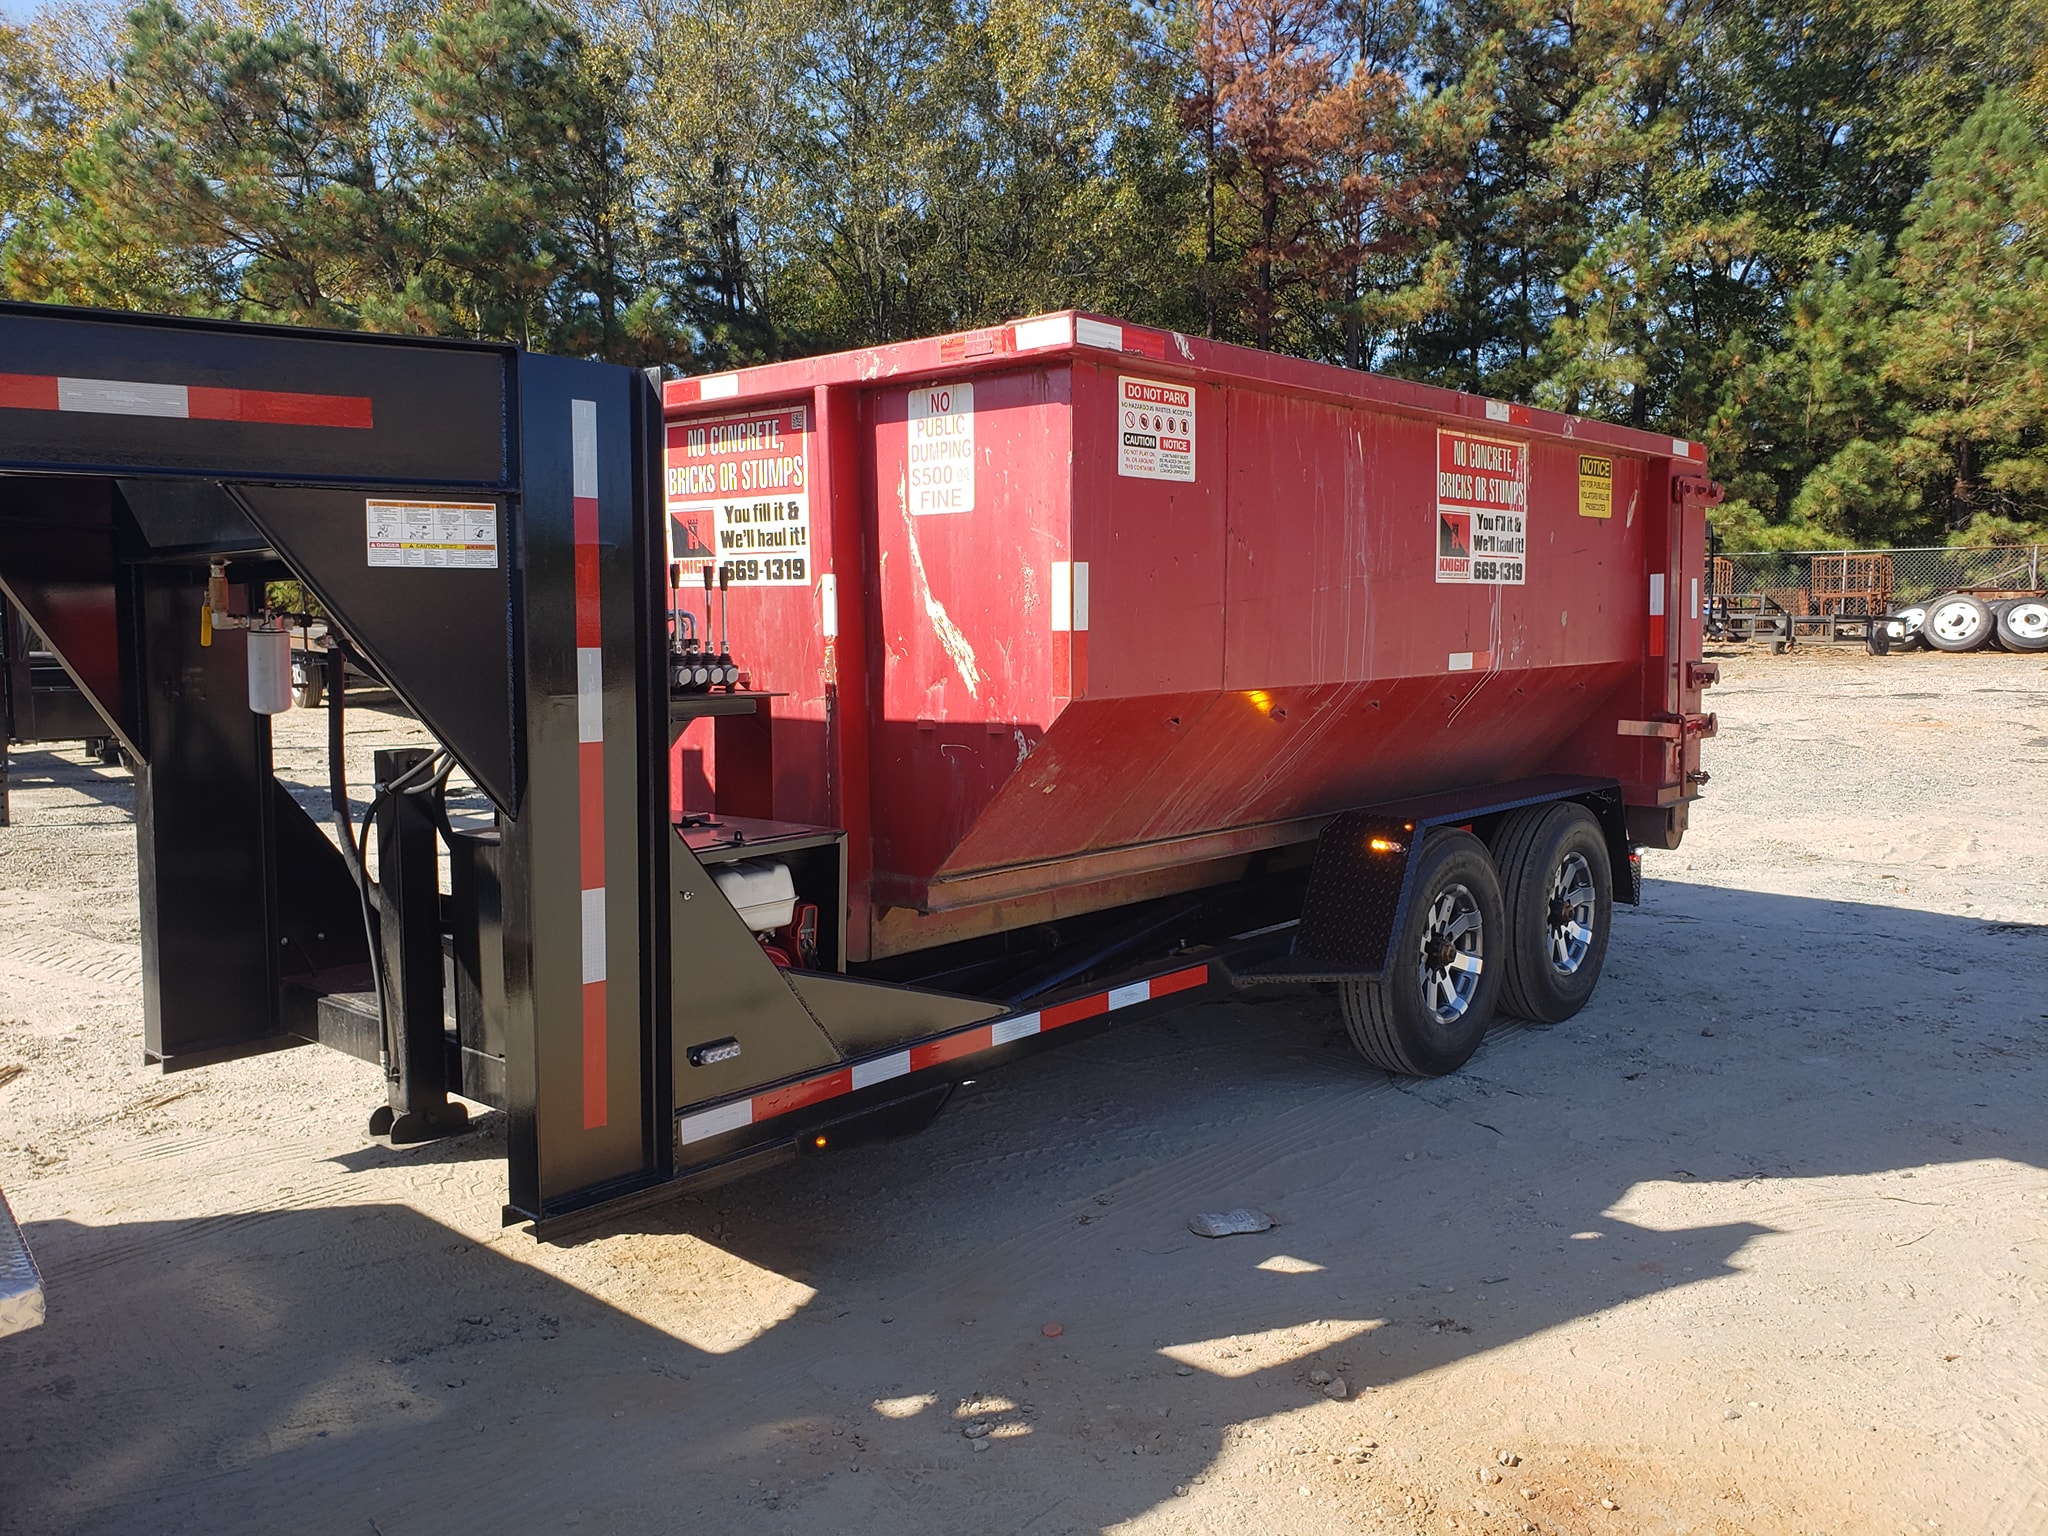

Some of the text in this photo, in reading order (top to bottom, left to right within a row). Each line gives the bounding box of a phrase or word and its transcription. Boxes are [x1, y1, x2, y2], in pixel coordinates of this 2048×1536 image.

[930, 392, 950, 413] NO
[1127, 385, 1187, 405] DO NOT PARK
[917, 414, 965, 439] PUBLIC
[687, 419, 785, 458] NO CONCRETE,
[1125, 434, 1155, 447] CAUTION
[1163, 440, 1188, 451] NOTICE
[911, 438, 972, 463] DUMPING
[1453, 440, 1514, 477] NO CONCRETE,
[668, 455, 803, 496] BRICKS OR STUMPS
[1581, 459, 1610, 477] NOTICE
[920, 488, 962, 509] FINE
[1440, 471, 1524, 506] BRICKS OR STUMPS
[724, 501, 800, 523] You fill it &
[1476, 513, 1493, 530] You
[1507, 517, 1513, 532] it
[1515, 518, 1521, 533] &
[720, 527, 806, 549] We'll haul it!
[1474, 534, 1496, 552] We'll
[1515, 538, 1524, 554] it!
[1439, 557, 1470, 573] KNIGHT
[1474, 561, 1523, 581] 669-1319
